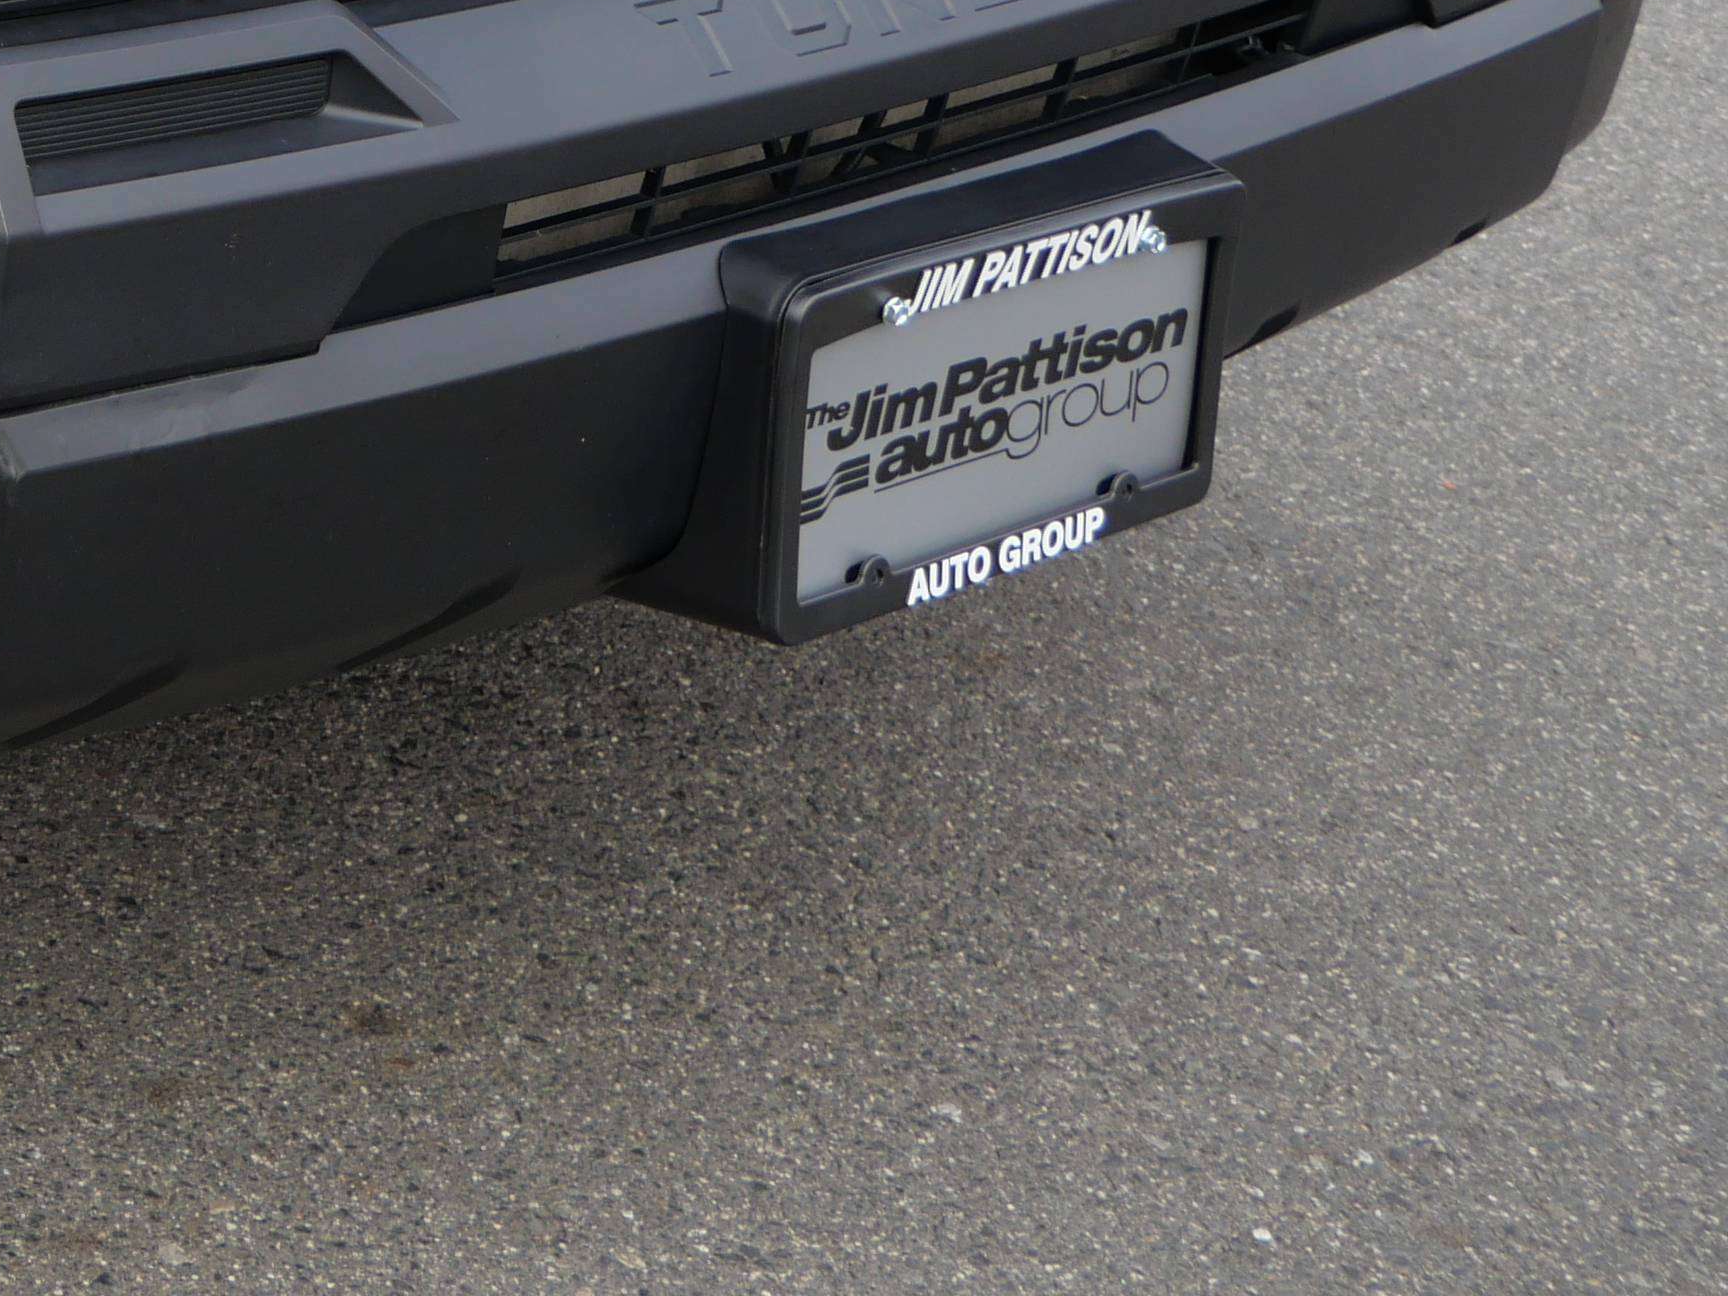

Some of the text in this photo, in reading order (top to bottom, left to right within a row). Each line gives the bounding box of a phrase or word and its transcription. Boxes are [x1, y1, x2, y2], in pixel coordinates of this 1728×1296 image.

[905, 209, 1153, 316] JIM PATTISON
[802, 307, 1189, 451] The Jim Pattison
[907, 506, 1107, 607] AUTO GROUP
